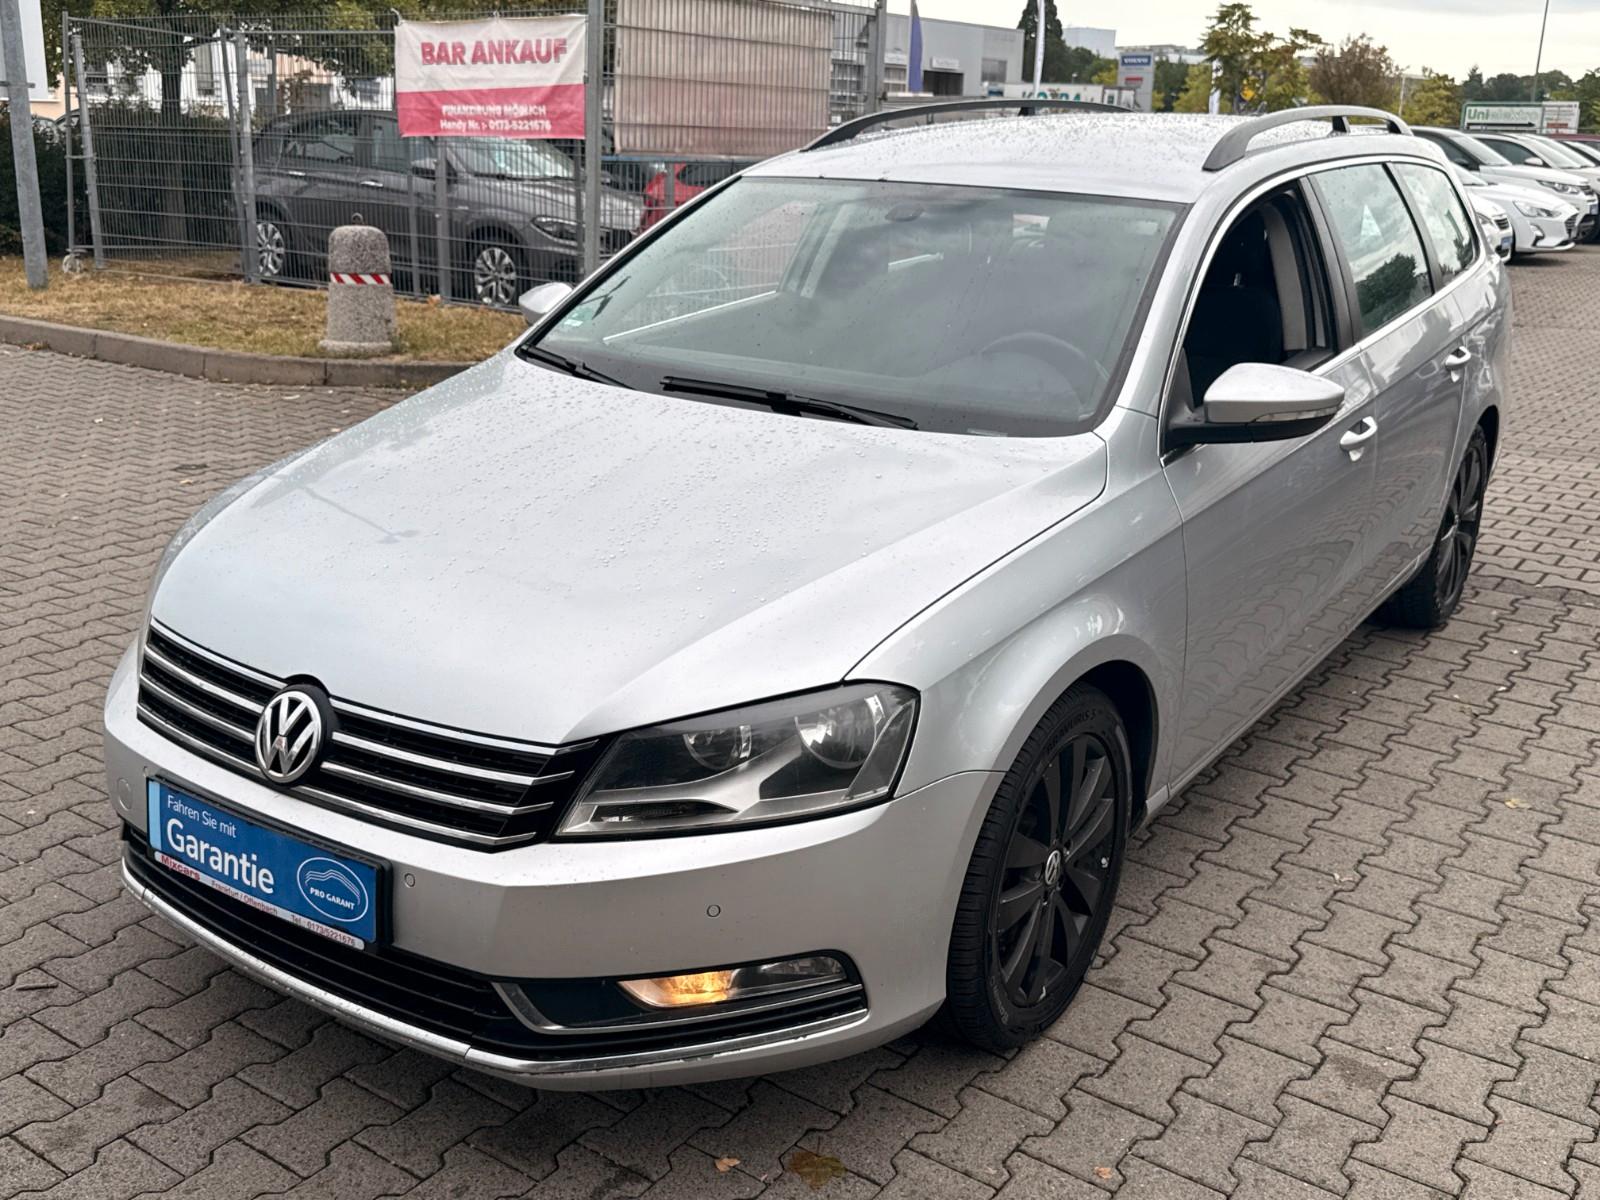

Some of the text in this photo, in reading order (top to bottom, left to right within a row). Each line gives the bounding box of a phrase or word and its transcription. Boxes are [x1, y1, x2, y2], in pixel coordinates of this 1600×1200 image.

[420, 38, 567, 66] BAR ANKAUF
[440, 119, 467, 133] Handy
[167, 794, 237, 839] Fahren Sie mit
[167, 818, 275, 894] Garantie
[309, 886, 356, 911] PRO GARANT
